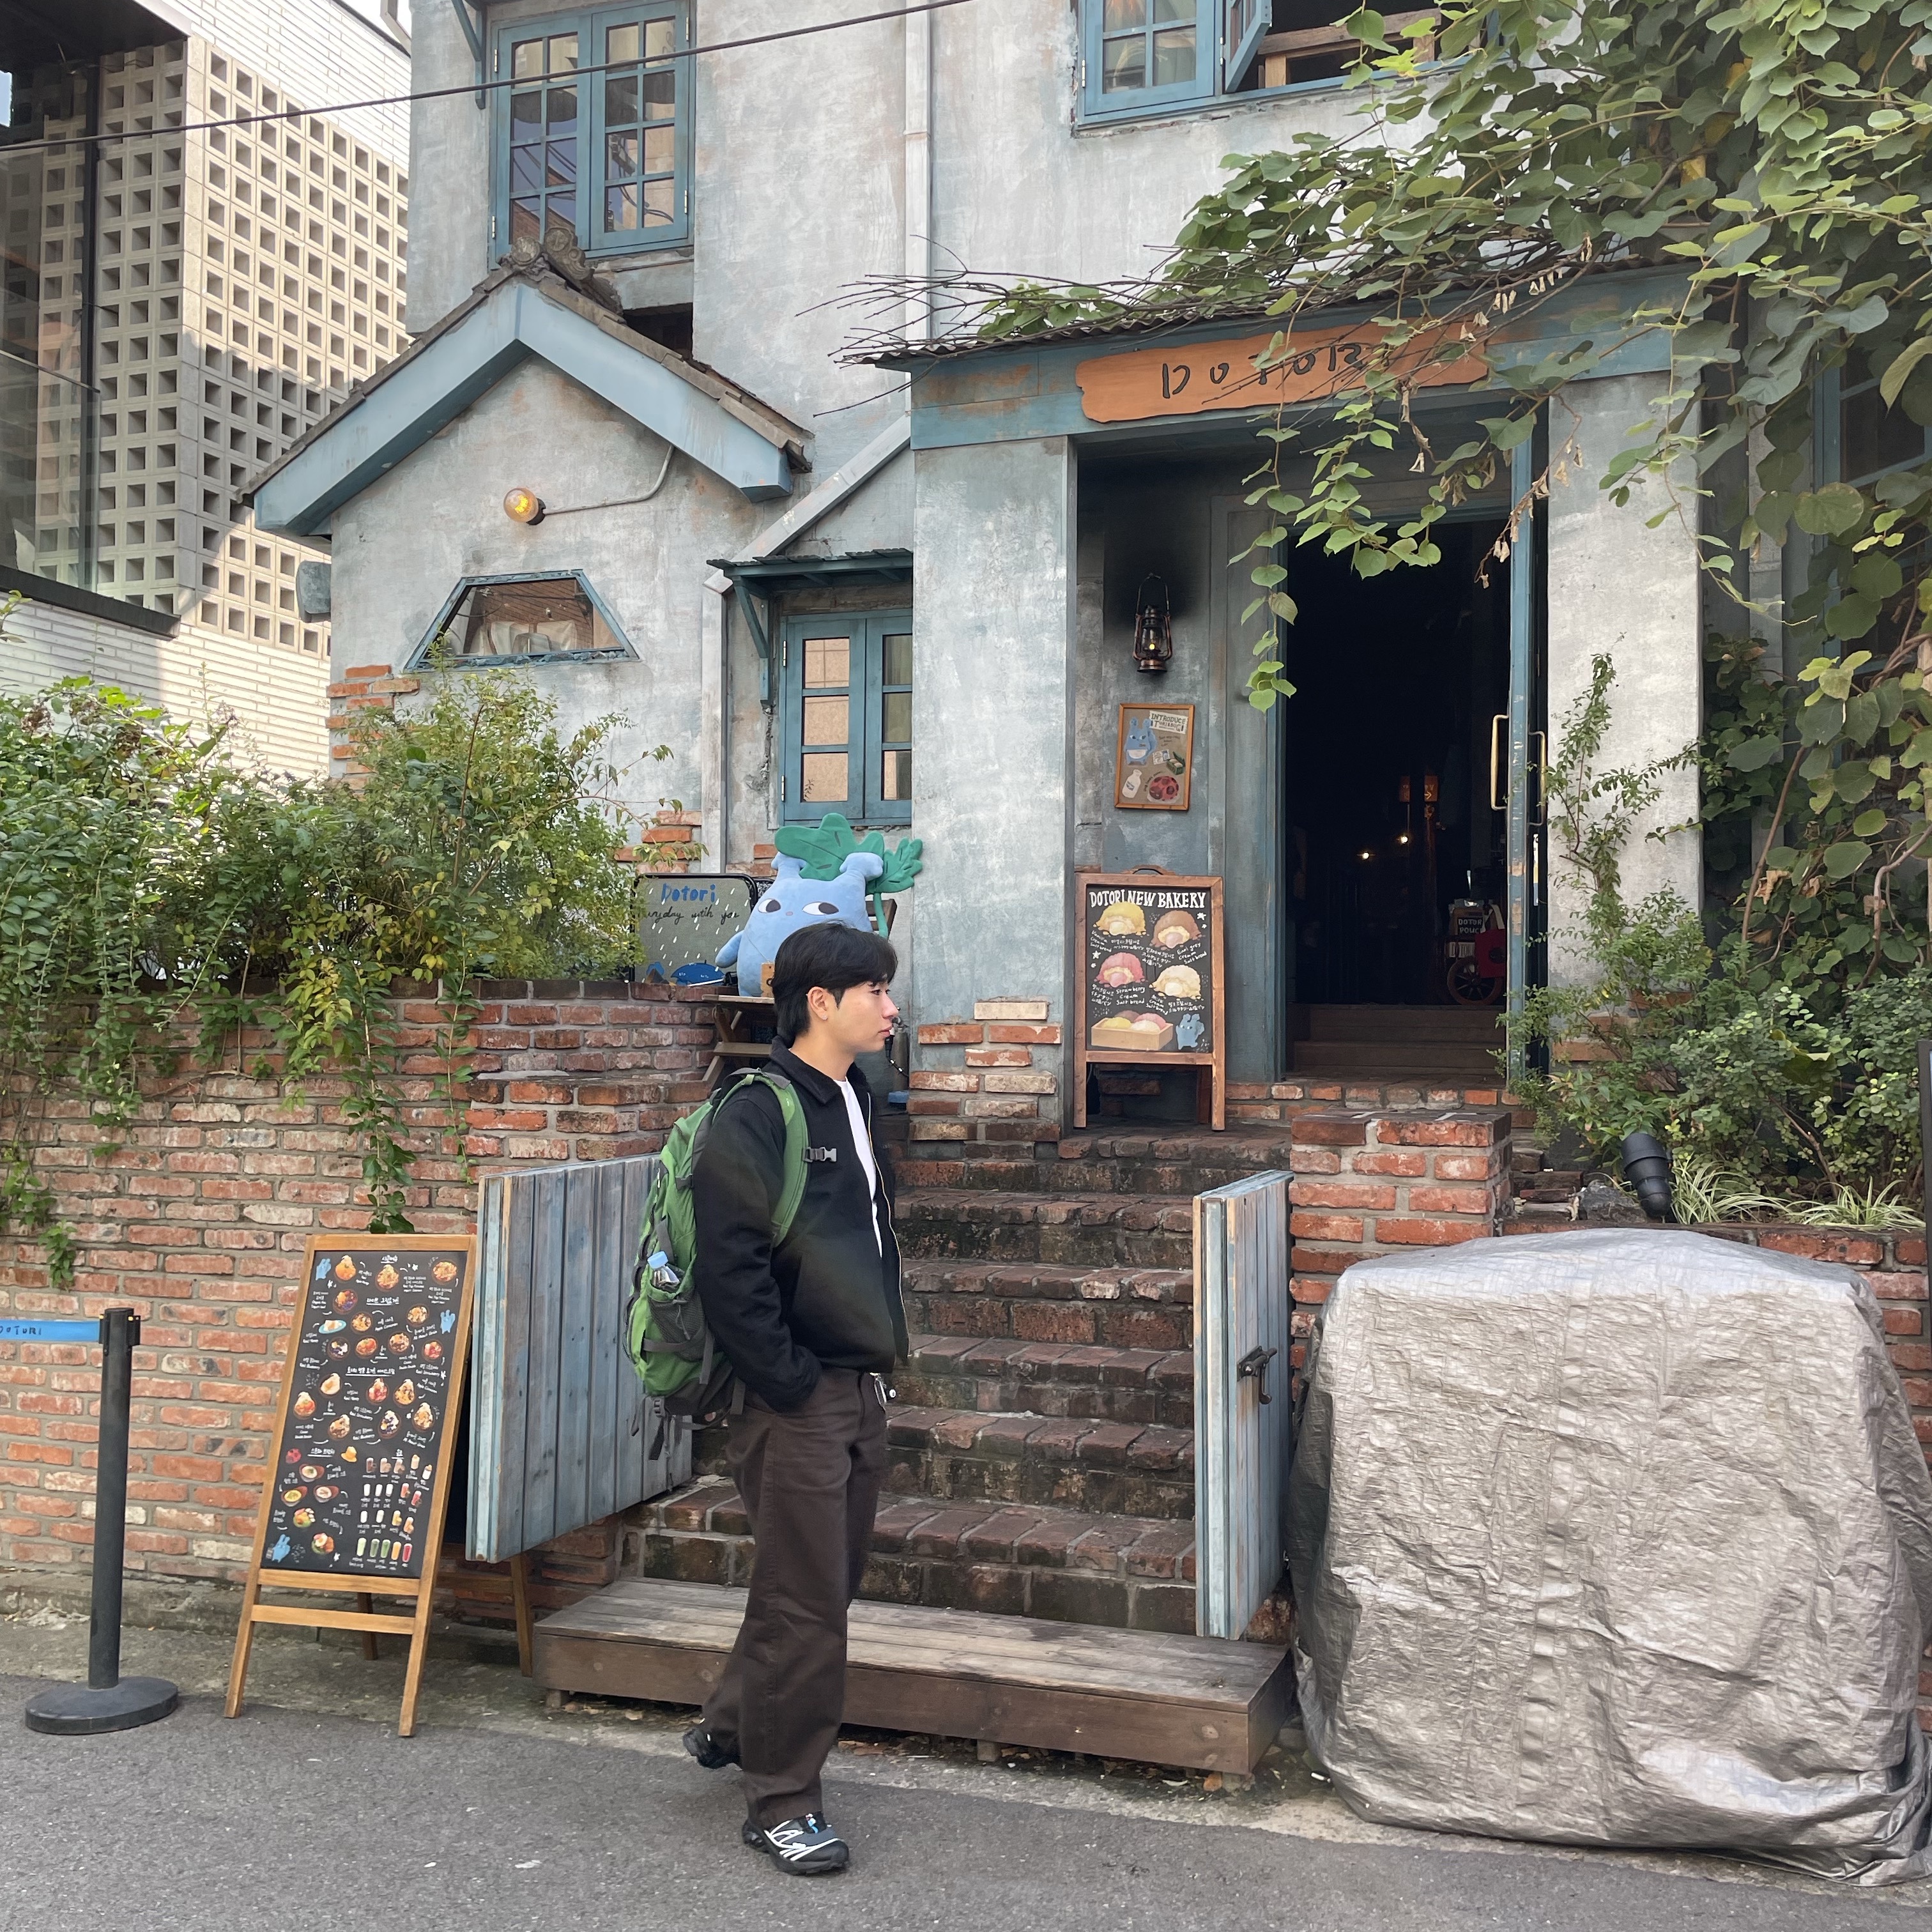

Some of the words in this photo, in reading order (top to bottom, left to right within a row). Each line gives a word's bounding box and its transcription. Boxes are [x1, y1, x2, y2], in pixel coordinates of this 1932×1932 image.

[1151, 713, 1186, 724] INTRODUCE
[661, 882, 716, 903] Dotori
[1089, 889, 1126, 908] DOTORI
[1127, 889, 1157, 907] NEW
[1157, 891, 1206, 909] BAKERY
[1116, 986, 1146, 995] Strawberry
